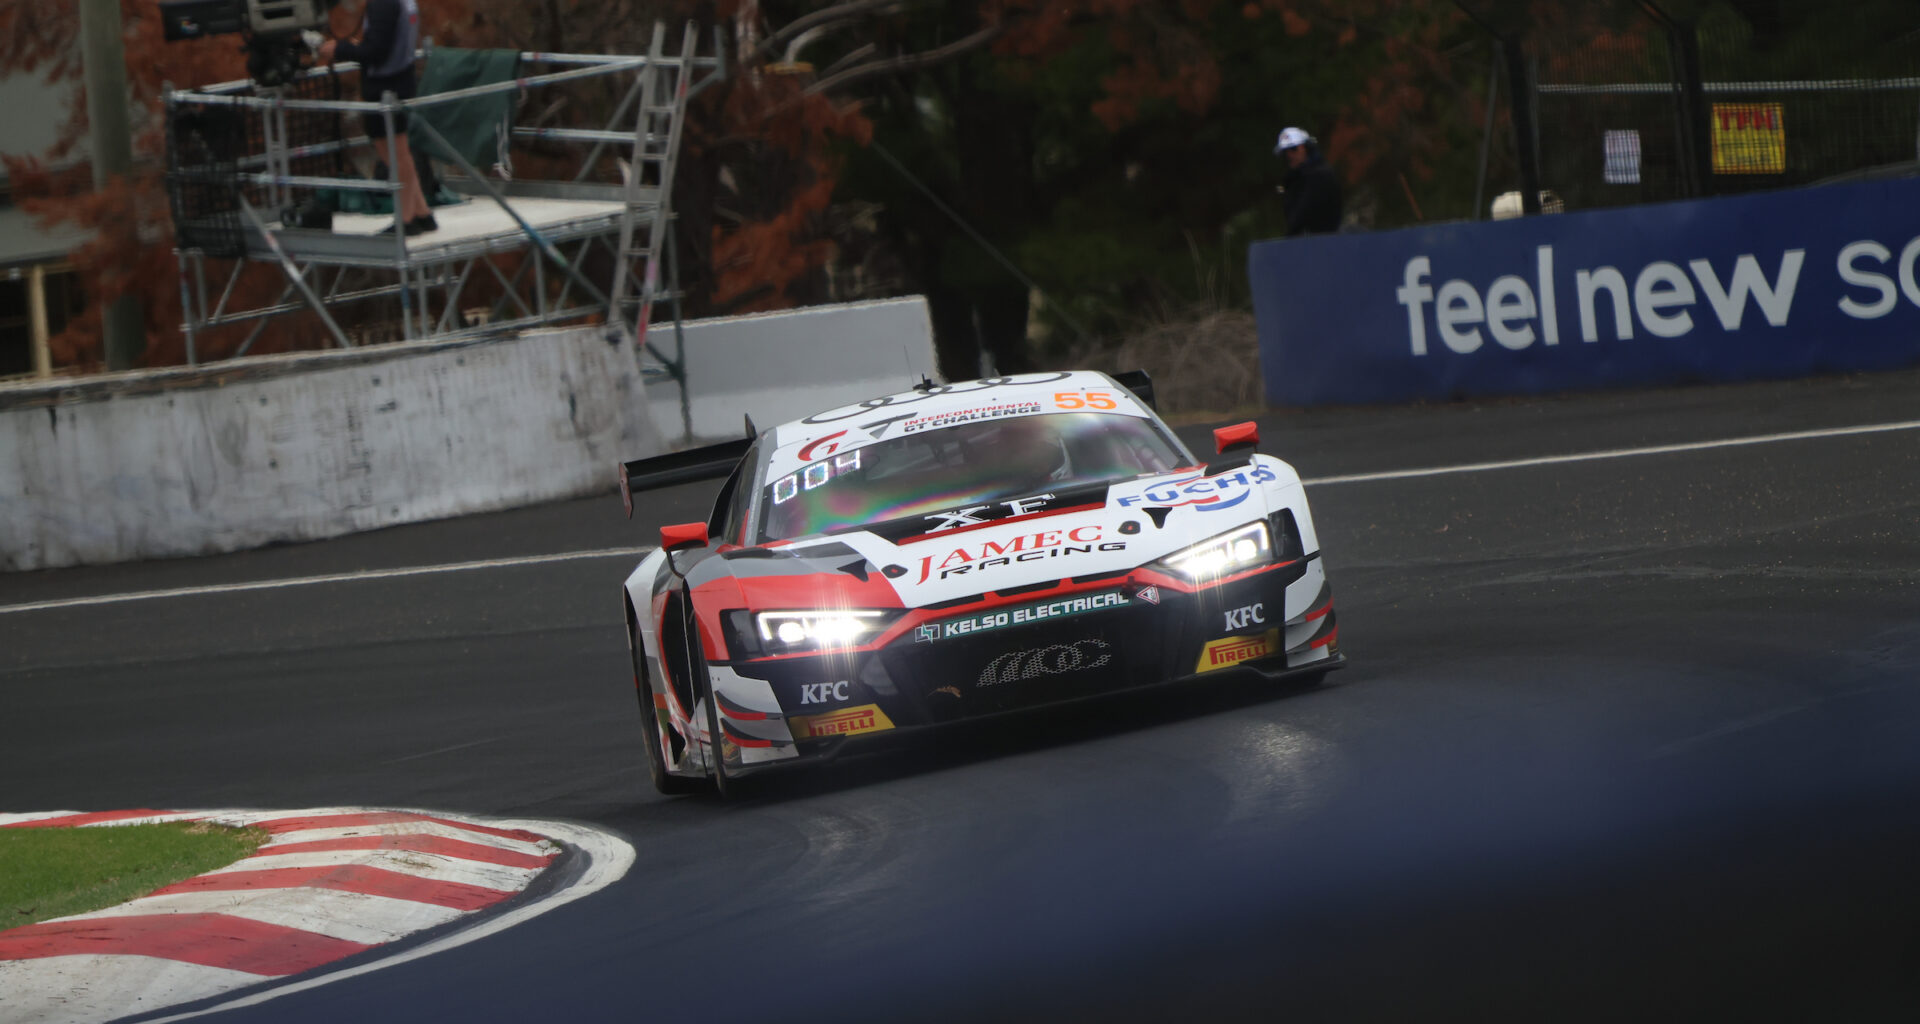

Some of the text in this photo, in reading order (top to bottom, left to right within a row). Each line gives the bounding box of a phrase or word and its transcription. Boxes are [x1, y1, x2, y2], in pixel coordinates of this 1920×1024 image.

[1396, 244, 1560, 357] feel
[1575, 248, 1807, 343] new
[904, 401, 1042, 427] INTERCONTINENTAL
[1053, 391, 1118, 410] 55
[904, 405, 1042, 433] GT CHALLENGE
[773, 449, 861, 506] 004
[1116, 464, 1277, 508] FUCHS
[916, 525, 1103, 585] JAMEC
[940, 541, 1127, 580] RACING
[945, 591, 1130, 638] KELSO ELECTRICAL
[1224, 603, 1265, 632] KFC
[1208, 636, 1268, 666] PIRELLI
[800, 680, 850, 705] KFC
[807, 709, 876, 737] PIRELLI
